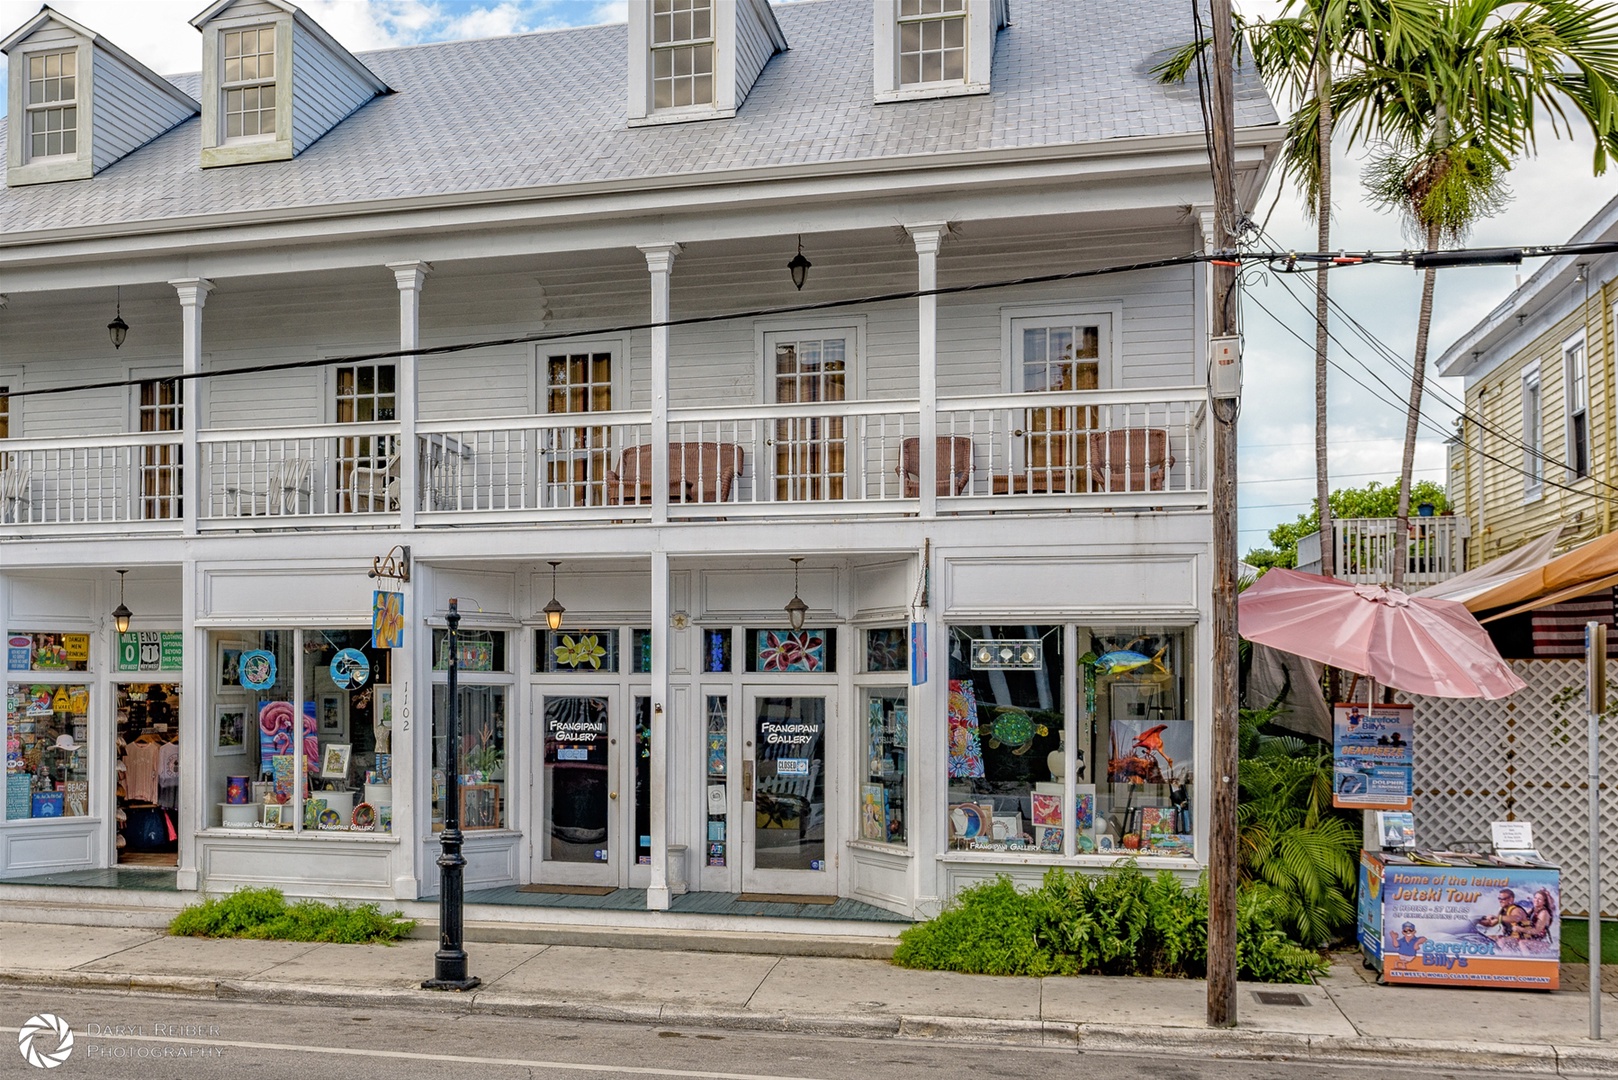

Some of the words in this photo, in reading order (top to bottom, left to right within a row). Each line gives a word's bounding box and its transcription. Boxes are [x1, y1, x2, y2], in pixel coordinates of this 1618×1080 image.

[121, 633, 137, 643] MILE
[140, 632, 158, 642] END
[125, 645, 134, 662] 0
[148, 647, 152, 660] 1
[402, 681, 410, 731] 1102
[1362, 716, 1400, 724] Barefoot
[550, 720, 603, 731] FRANGIPANI
[761, 722, 819, 733] FRANGIPANI
[1362, 722, 1386, 731] Billy's
[555, 730, 598, 741] GALLERY
[767, 733, 812, 744] GALLERY
[778, 760, 797, 769] CLOSED
[67, 783, 87, 792] BEACH
[67, 792, 87, 802] HOUSE
[253, 821, 277, 829] GALLERY
[318, 823, 349, 831] FRANGIPANI
[969, 842, 1008, 851] FRANGIPANI
[1009, 843, 1041, 852] GALLERY
[1098, 846, 1138, 855] FRANGIPANI
[1139, 847, 1171, 856] GALLERY
[1393, 873, 1429, 885] Home
[1432, 874, 1446, 885] of
[1448, 875, 1468, 886] the
[1471, 876, 1509, 887] Island
[1392, 886, 1441, 902] Jetski
[1446, 888, 1482, 903] Tour
[1445, 906, 1470, 914] MILES
[1422, 939, 1495, 955] Barefoot
[1422, 953, 1468, 970] Billy's
[1518, 976, 1551, 984] COMPANY
